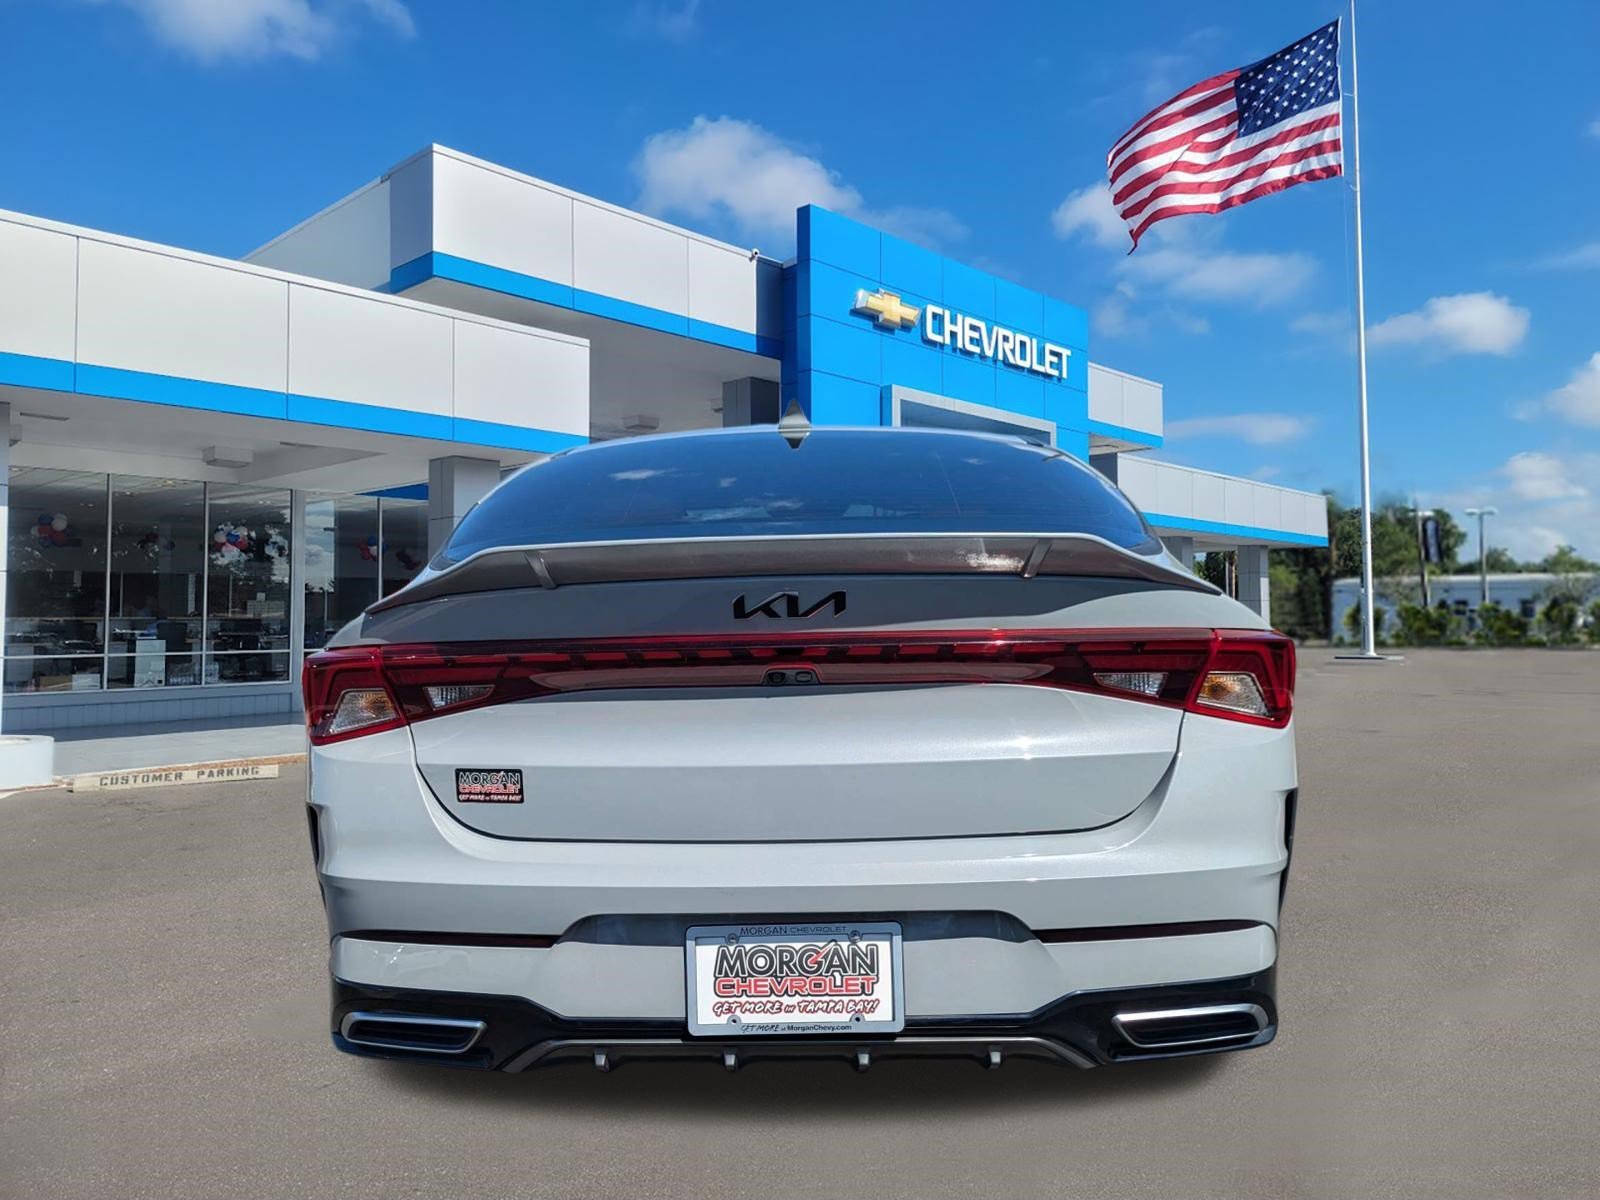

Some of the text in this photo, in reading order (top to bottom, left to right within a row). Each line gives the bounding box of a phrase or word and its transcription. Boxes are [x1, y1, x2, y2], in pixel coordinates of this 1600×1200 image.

[923, 303, 1072, 379] CHEVROLET
[732, 589, 847, 619] KIA
[99, 766, 259, 787] CUSTOMER PARKING
[458, 772, 520, 785] MORGAN
[458, 784, 520, 794] CHEVROLET
[740, 926, 847, 936] MORGAN CHEVROLET
[714, 941, 880, 978] MORGAN
[714, 976, 877, 997] CHEVROLET
[712, 1000, 741, 1016] GET
[740, 1000, 783, 1014] MORE
[797, 1000, 844, 1013] TAMPA
[845, 999, 880, 1013] BAY!
[741, 1025, 755, 1033] GET
[756, 1024, 781, 1032] MORE
[787, 1024, 852, 1032] MorganChevy.com
